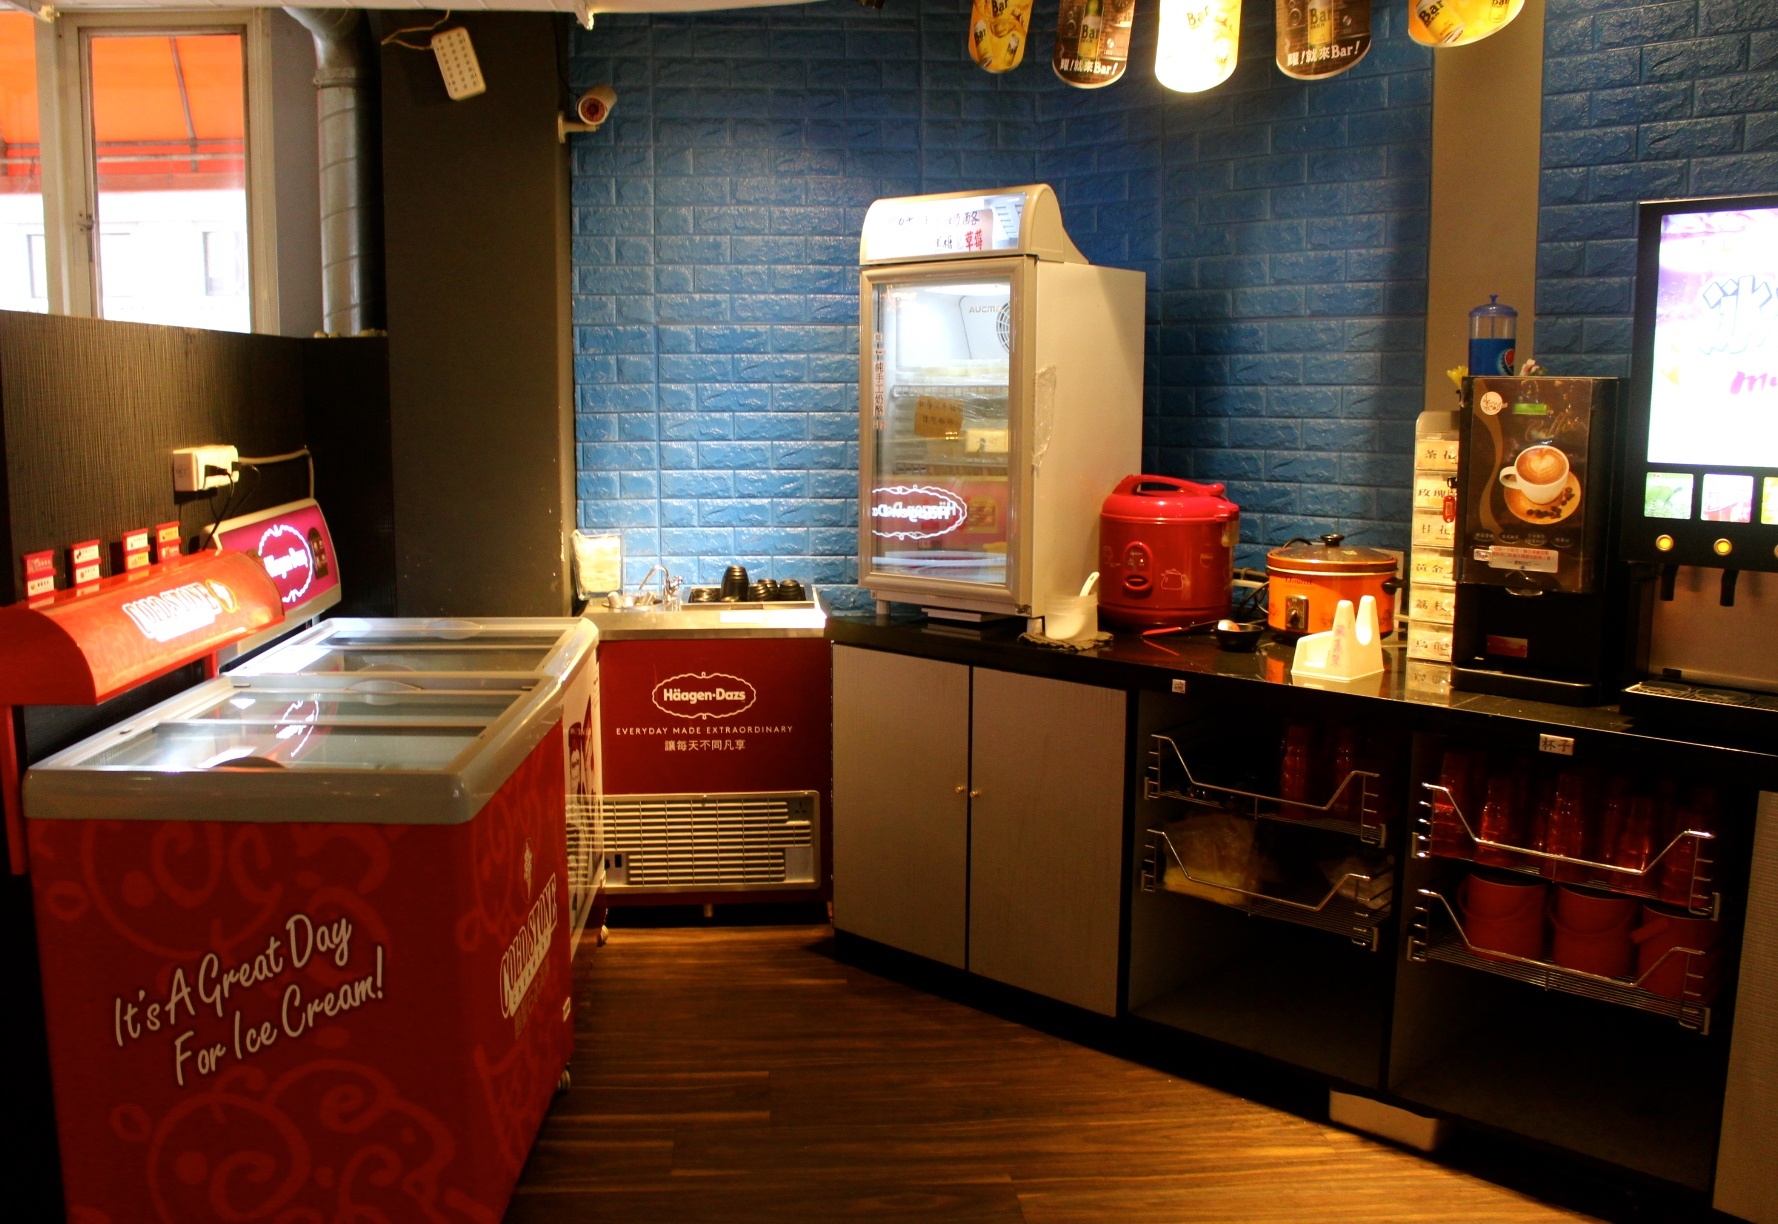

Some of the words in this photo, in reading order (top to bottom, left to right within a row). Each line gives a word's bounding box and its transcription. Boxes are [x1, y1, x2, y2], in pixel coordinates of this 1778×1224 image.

[1418, 0, 1444, 22] Bar
[616, 727, 668, 735] EVERYDAY
[672, 727, 701, 735] MADE
[706, 725, 793, 735] EXTRAORDINARY
[664, 739, 746, 751] 讓每天不同凡享
[1541, 737, 1571, 752] 杯子
[115, 990, 160, 1047] It's
[165, 968, 196, 1025] A
[198, 936, 284, 1018] Great
[286, 914, 352, 967] Day
[175, 1030, 226, 1086] For
[234, 1010, 278, 1060] Ice
[282, 945, 384, 1038] Cream!
